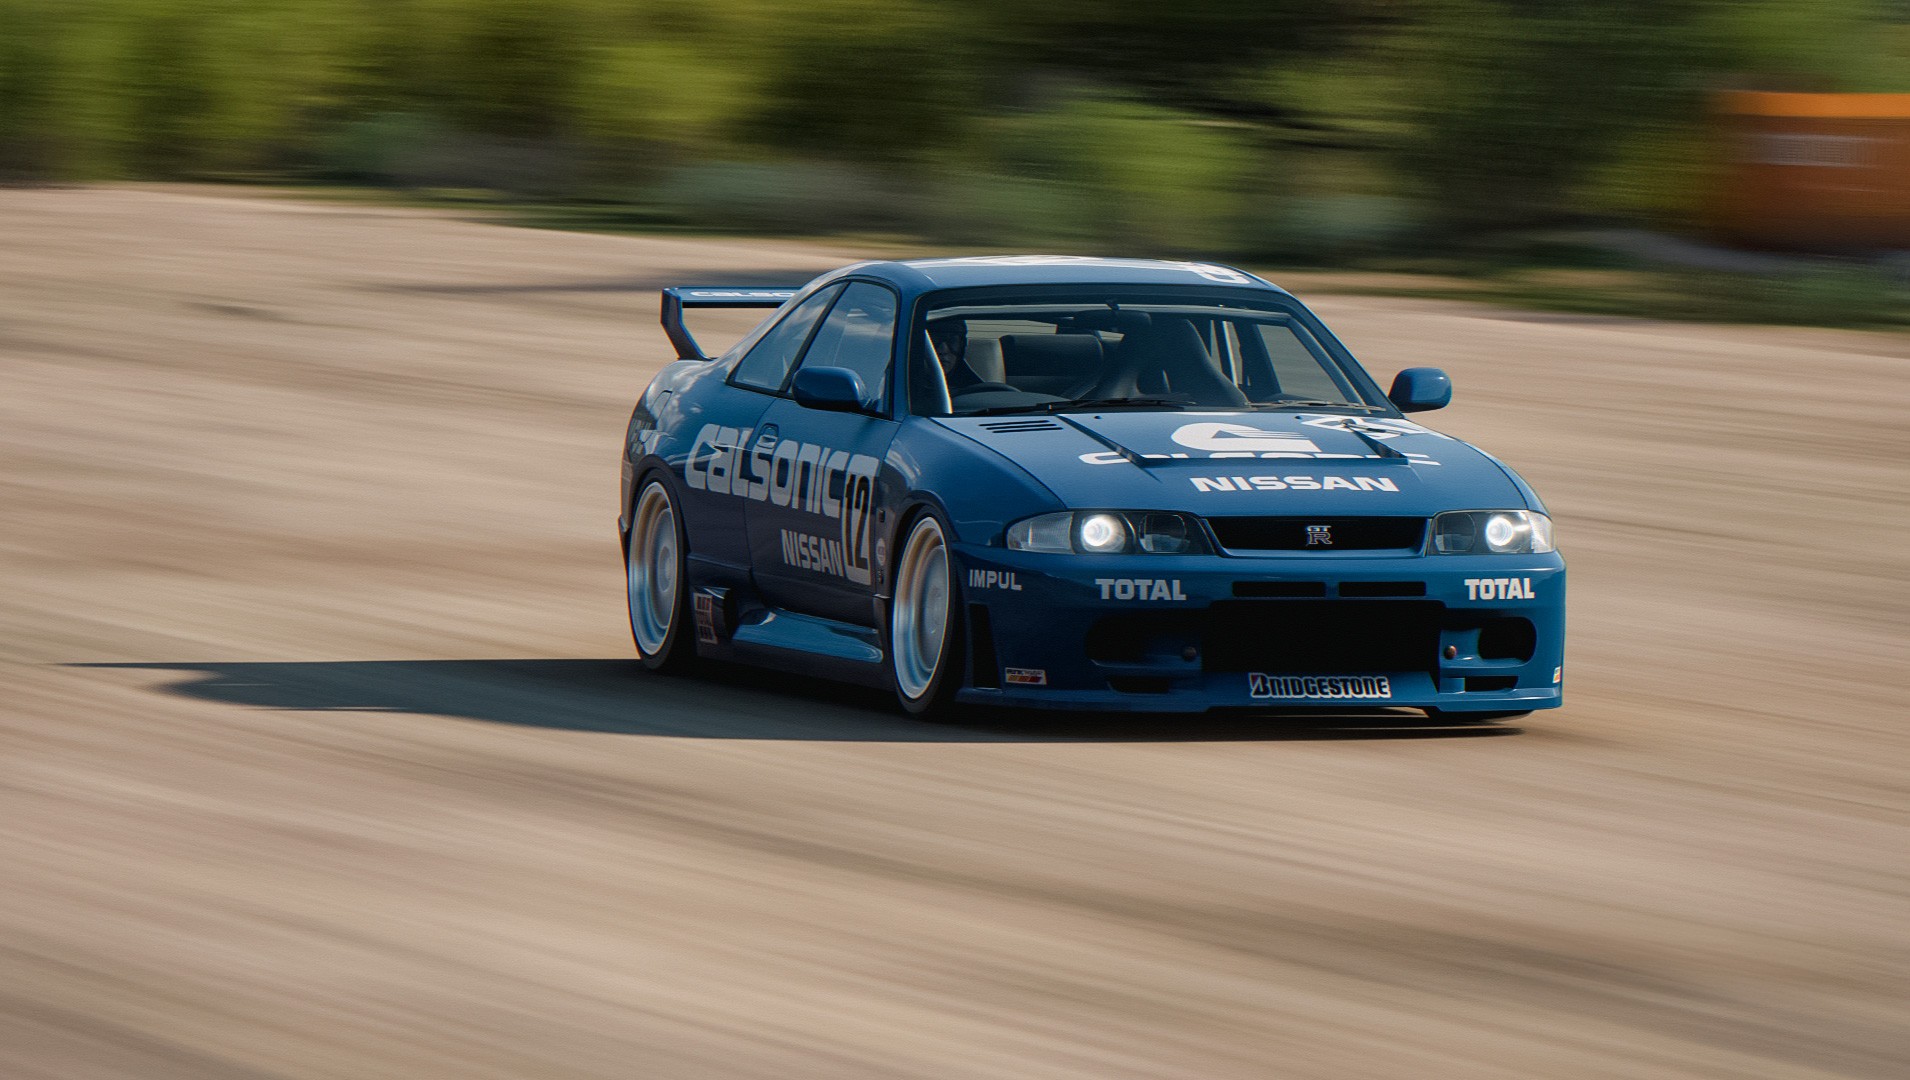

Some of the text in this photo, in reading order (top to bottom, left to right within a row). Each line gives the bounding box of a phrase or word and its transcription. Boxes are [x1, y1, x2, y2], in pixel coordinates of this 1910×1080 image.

[1189, 476, 1400, 492] NISSAN
[781, 529, 845, 577] NISSAN
[969, 569, 1022, 591] IMPUL
[1095, 579, 1187, 600] TOTAL
[1464, 578, 1536, 600] TOTAL
[1249, 673, 1391, 698] BRIDGESTONE
